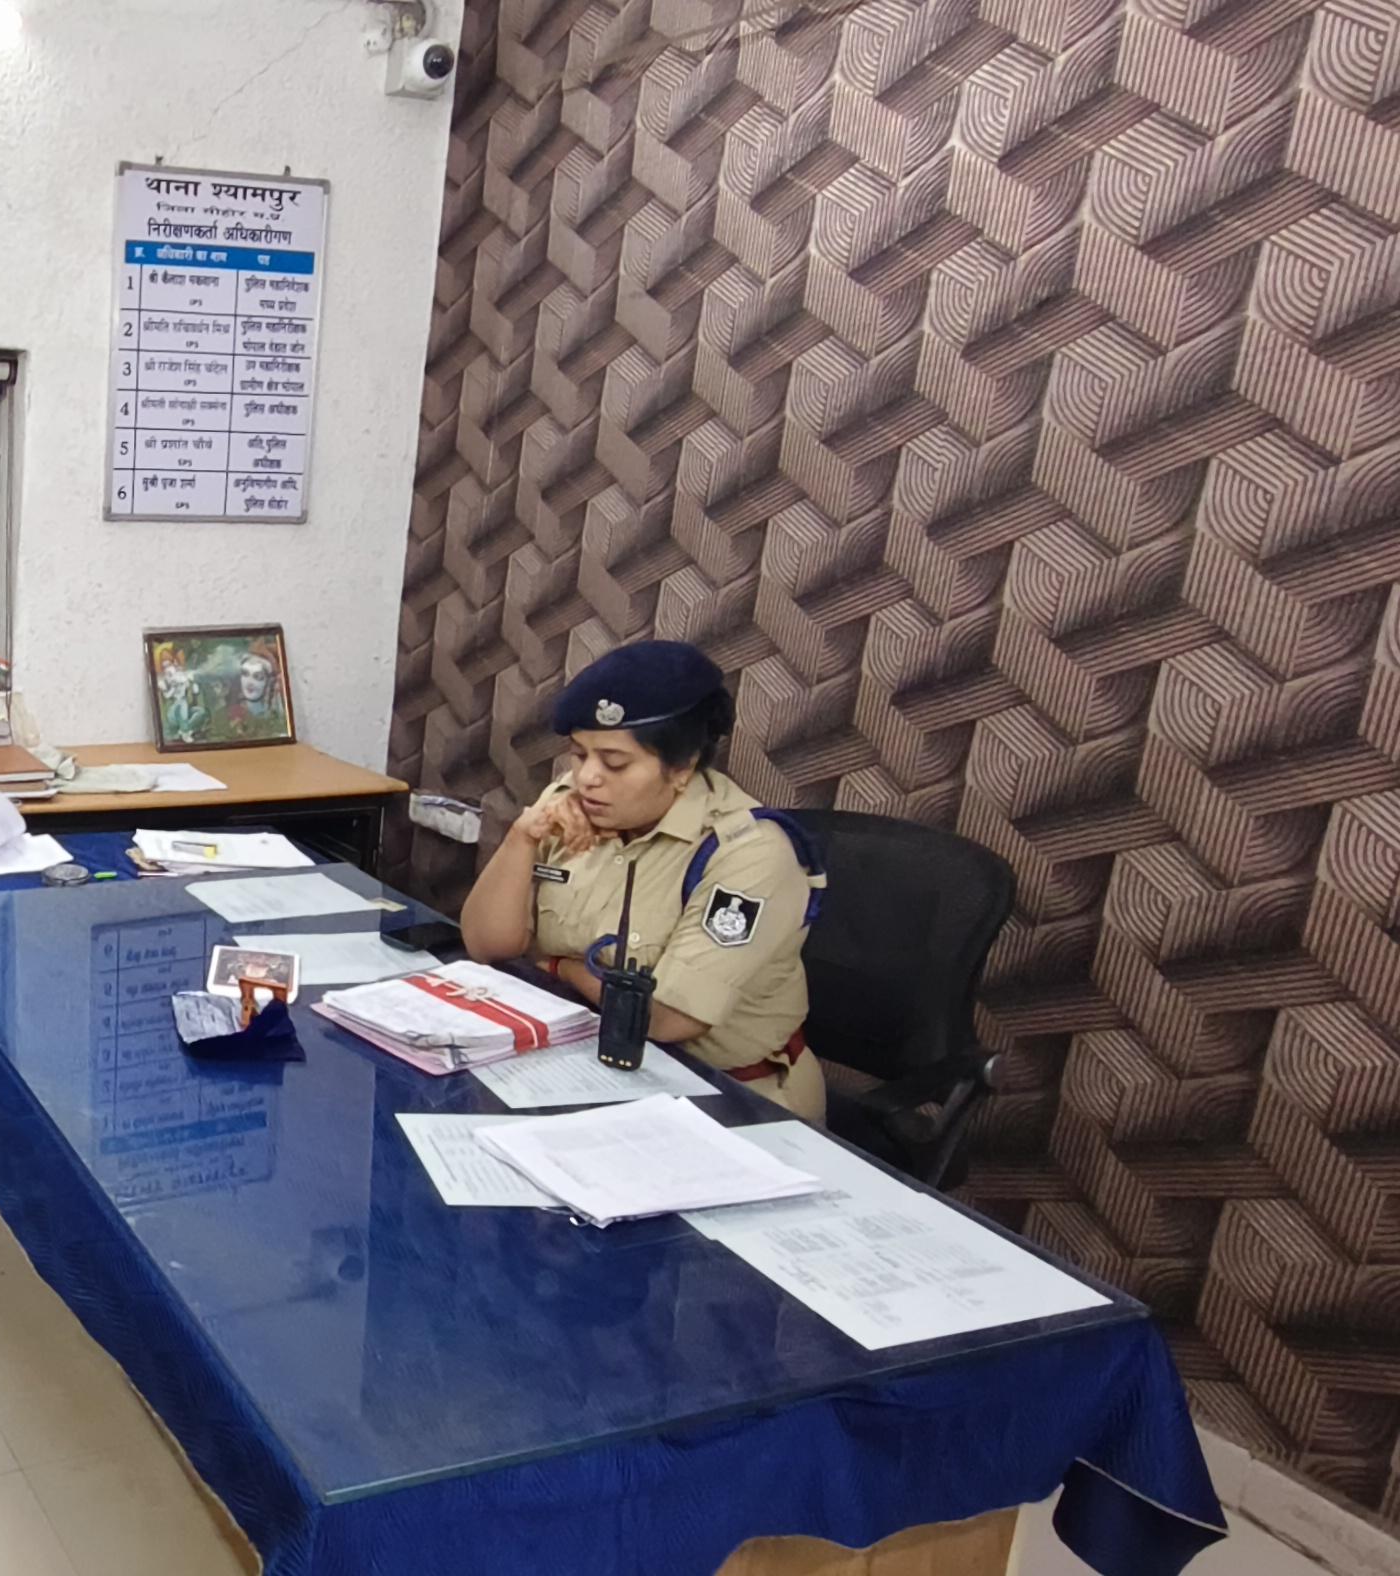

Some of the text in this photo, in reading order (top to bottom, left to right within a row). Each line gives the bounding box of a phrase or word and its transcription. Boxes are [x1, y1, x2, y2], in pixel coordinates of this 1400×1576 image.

[145, 177, 301, 212] थाना श्यामपुर
[147, 215, 292, 245] निरीक्षणकर्ता अधिकारीगण
[127, 275, 133, 289] 1
[123, 321, 133, 336] 2
[122, 361, 131, 376] 3
[120, 401, 128, 415] 4
[120, 441, 128, 455] 5
[117, 485, 126, 499] 6
